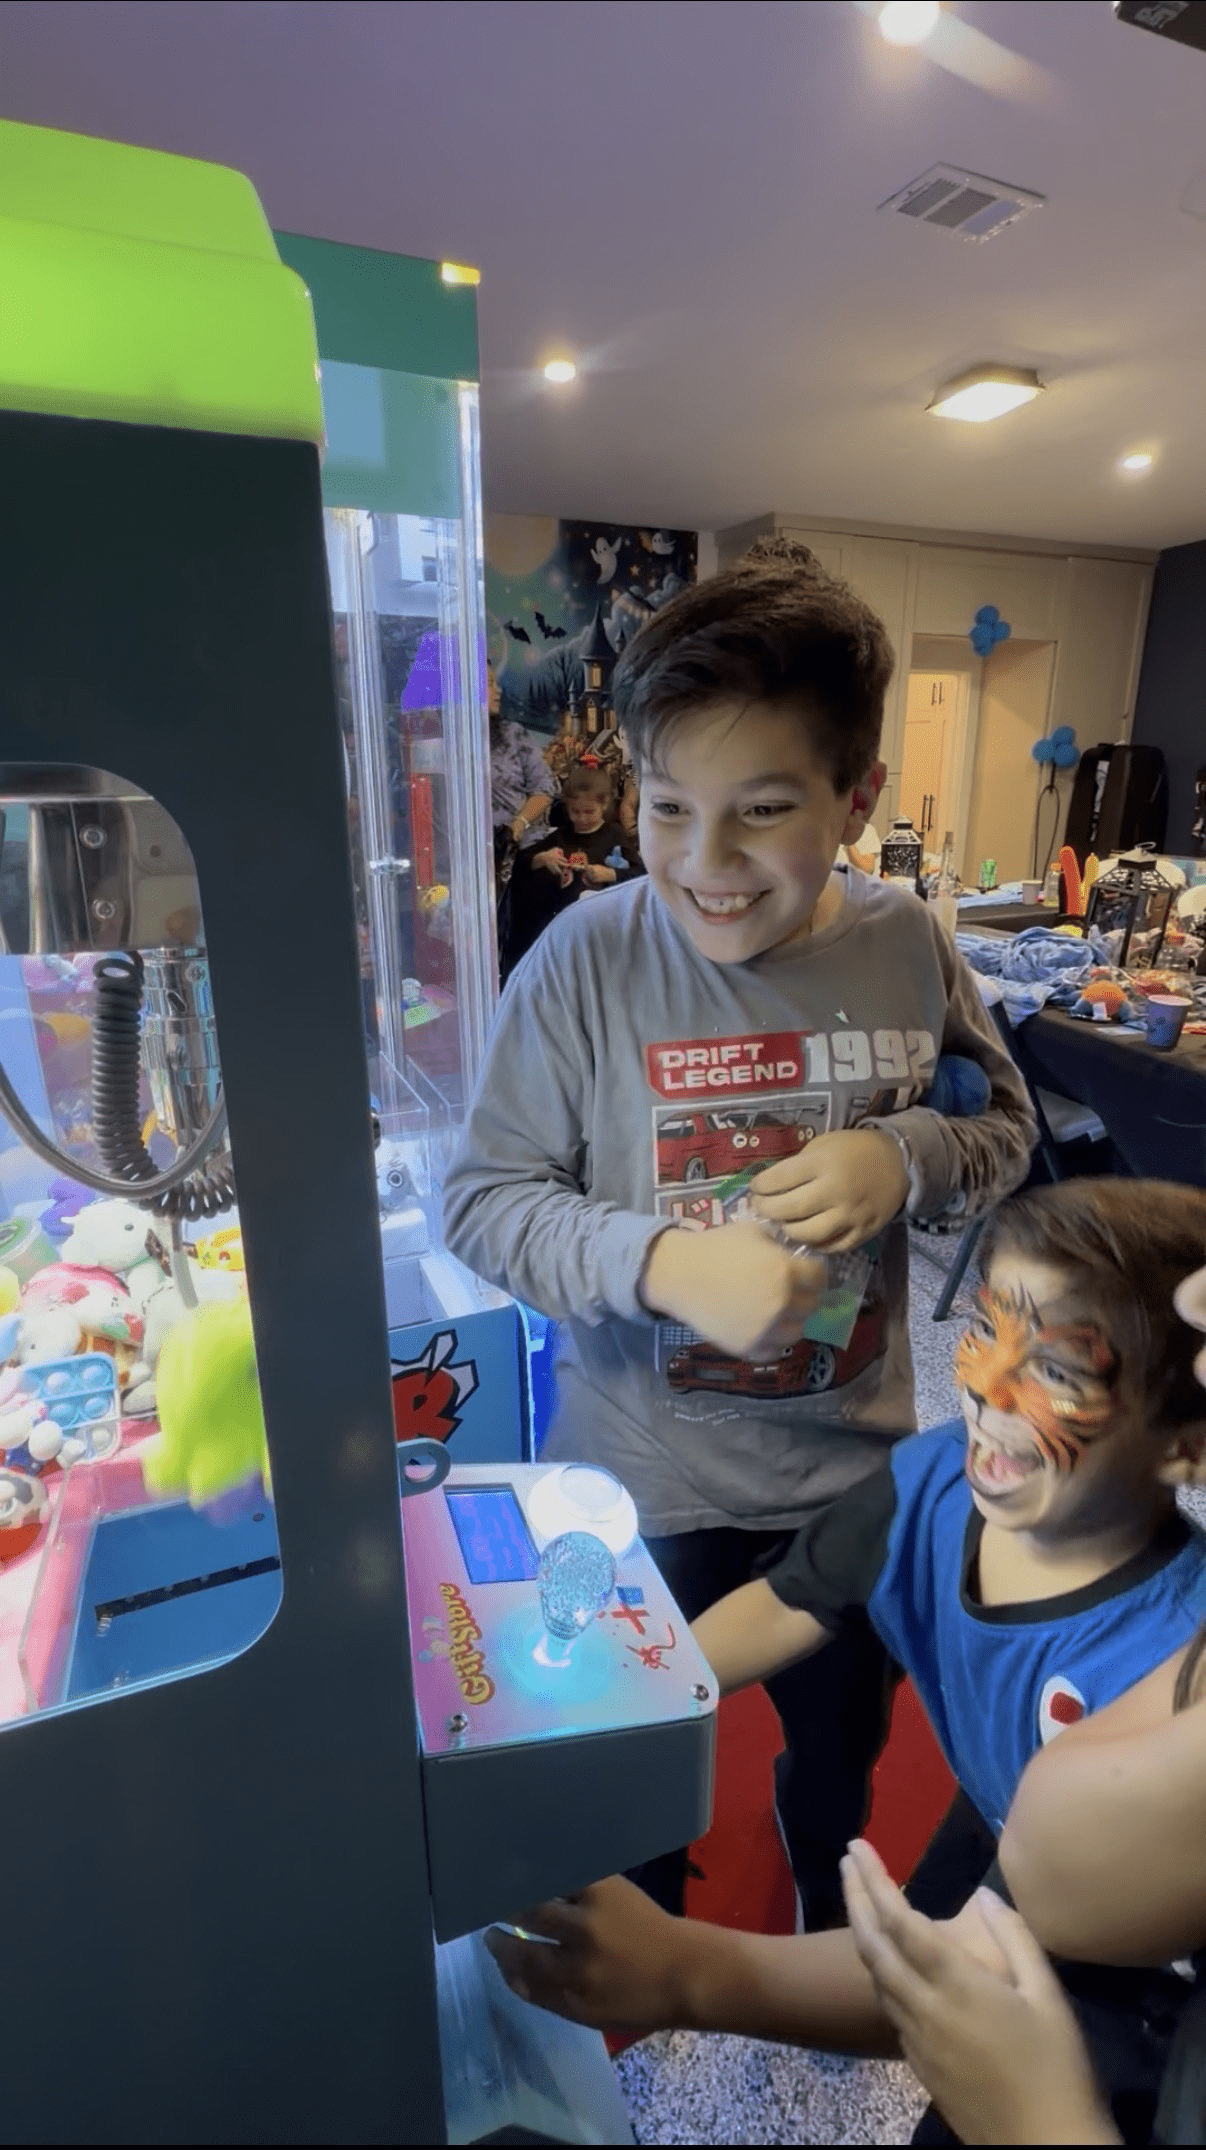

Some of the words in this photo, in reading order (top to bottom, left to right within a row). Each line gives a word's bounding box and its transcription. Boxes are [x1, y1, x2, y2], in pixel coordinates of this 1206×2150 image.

[659, 1042, 765, 1069] DRIFT
[806, 1029, 936, 1083] 1992
[663, 1060, 799, 1091] LEGEND
